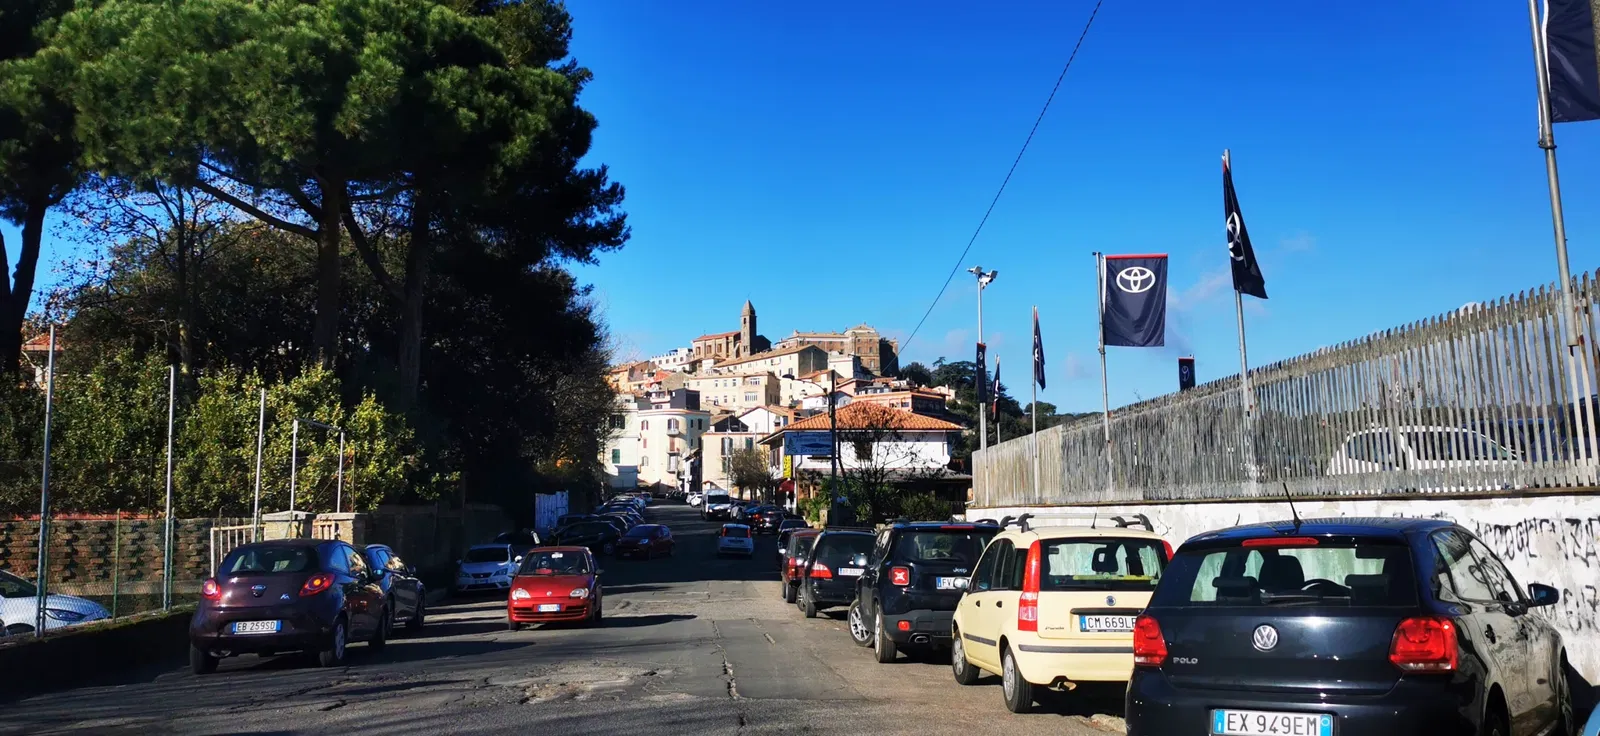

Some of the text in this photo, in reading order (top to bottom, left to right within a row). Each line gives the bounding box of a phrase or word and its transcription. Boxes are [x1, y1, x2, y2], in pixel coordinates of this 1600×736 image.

[942, 578, 952, 587] FV
[237, 622, 275, 631] EB 259SD
[1087, 617, 1101, 629] CM
[1227, 713, 1249, 731] EX
[1256, 714, 1317, 736] 949EM
